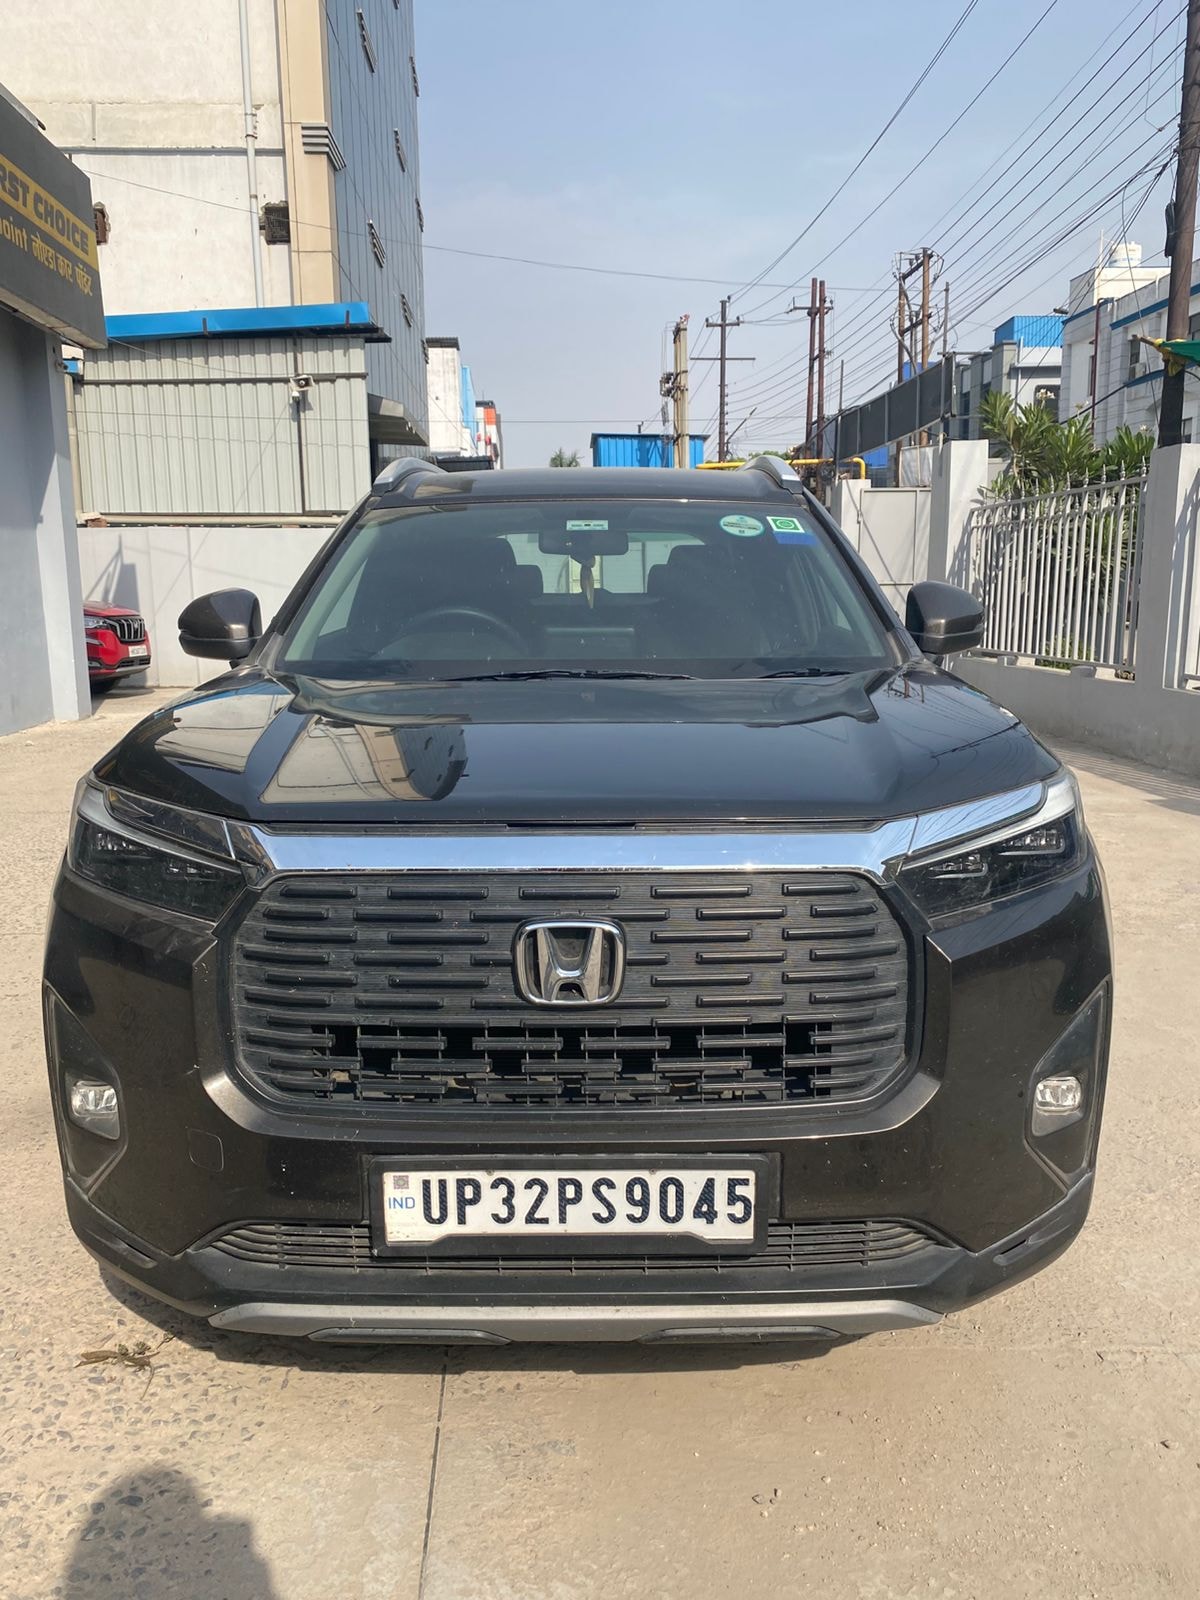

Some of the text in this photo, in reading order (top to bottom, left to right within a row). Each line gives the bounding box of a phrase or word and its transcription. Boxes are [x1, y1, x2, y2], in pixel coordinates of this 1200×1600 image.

[33, 191, 89, 256] CHOICE
[56, 252, 73, 283] कार
[388, 1196, 416, 1209] IND
[421, 1177, 753, 1225] UP32PS9045
